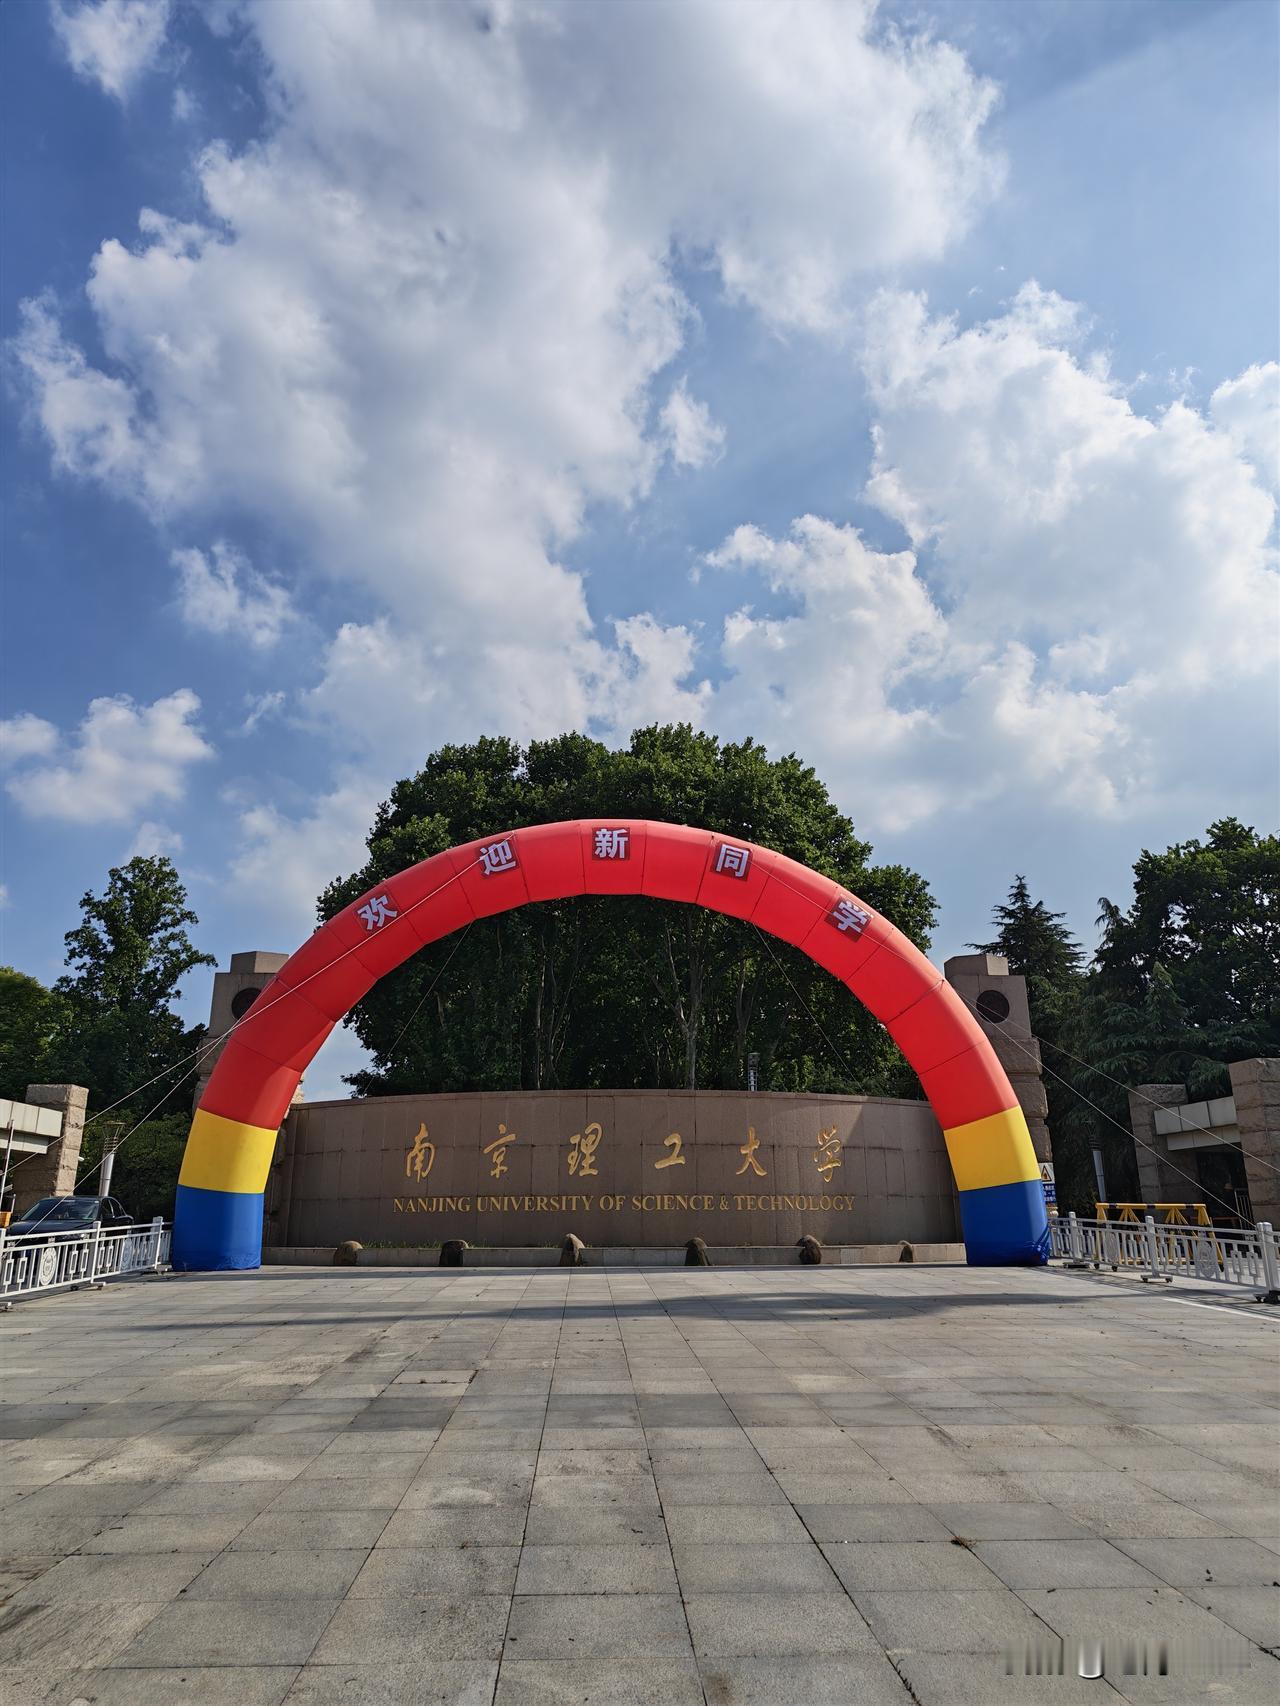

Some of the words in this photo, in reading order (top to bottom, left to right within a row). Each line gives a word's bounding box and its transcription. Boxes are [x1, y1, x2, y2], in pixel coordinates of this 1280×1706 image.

[356, 828, 873, 934] 欢迎新同学
[405, 1122, 843, 1183] 南京理工大学
[393, 1197, 471, 1212] NANJING
[476, 1196, 593, 1212] UNIVERSITY
[599, 1196, 624, 1211] OF
[632, 1195, 714, 1211] SCIENCE
[719, 1197, 730, 1211] &
[735, 1196, 856, 1211] TECHNOLOGY
